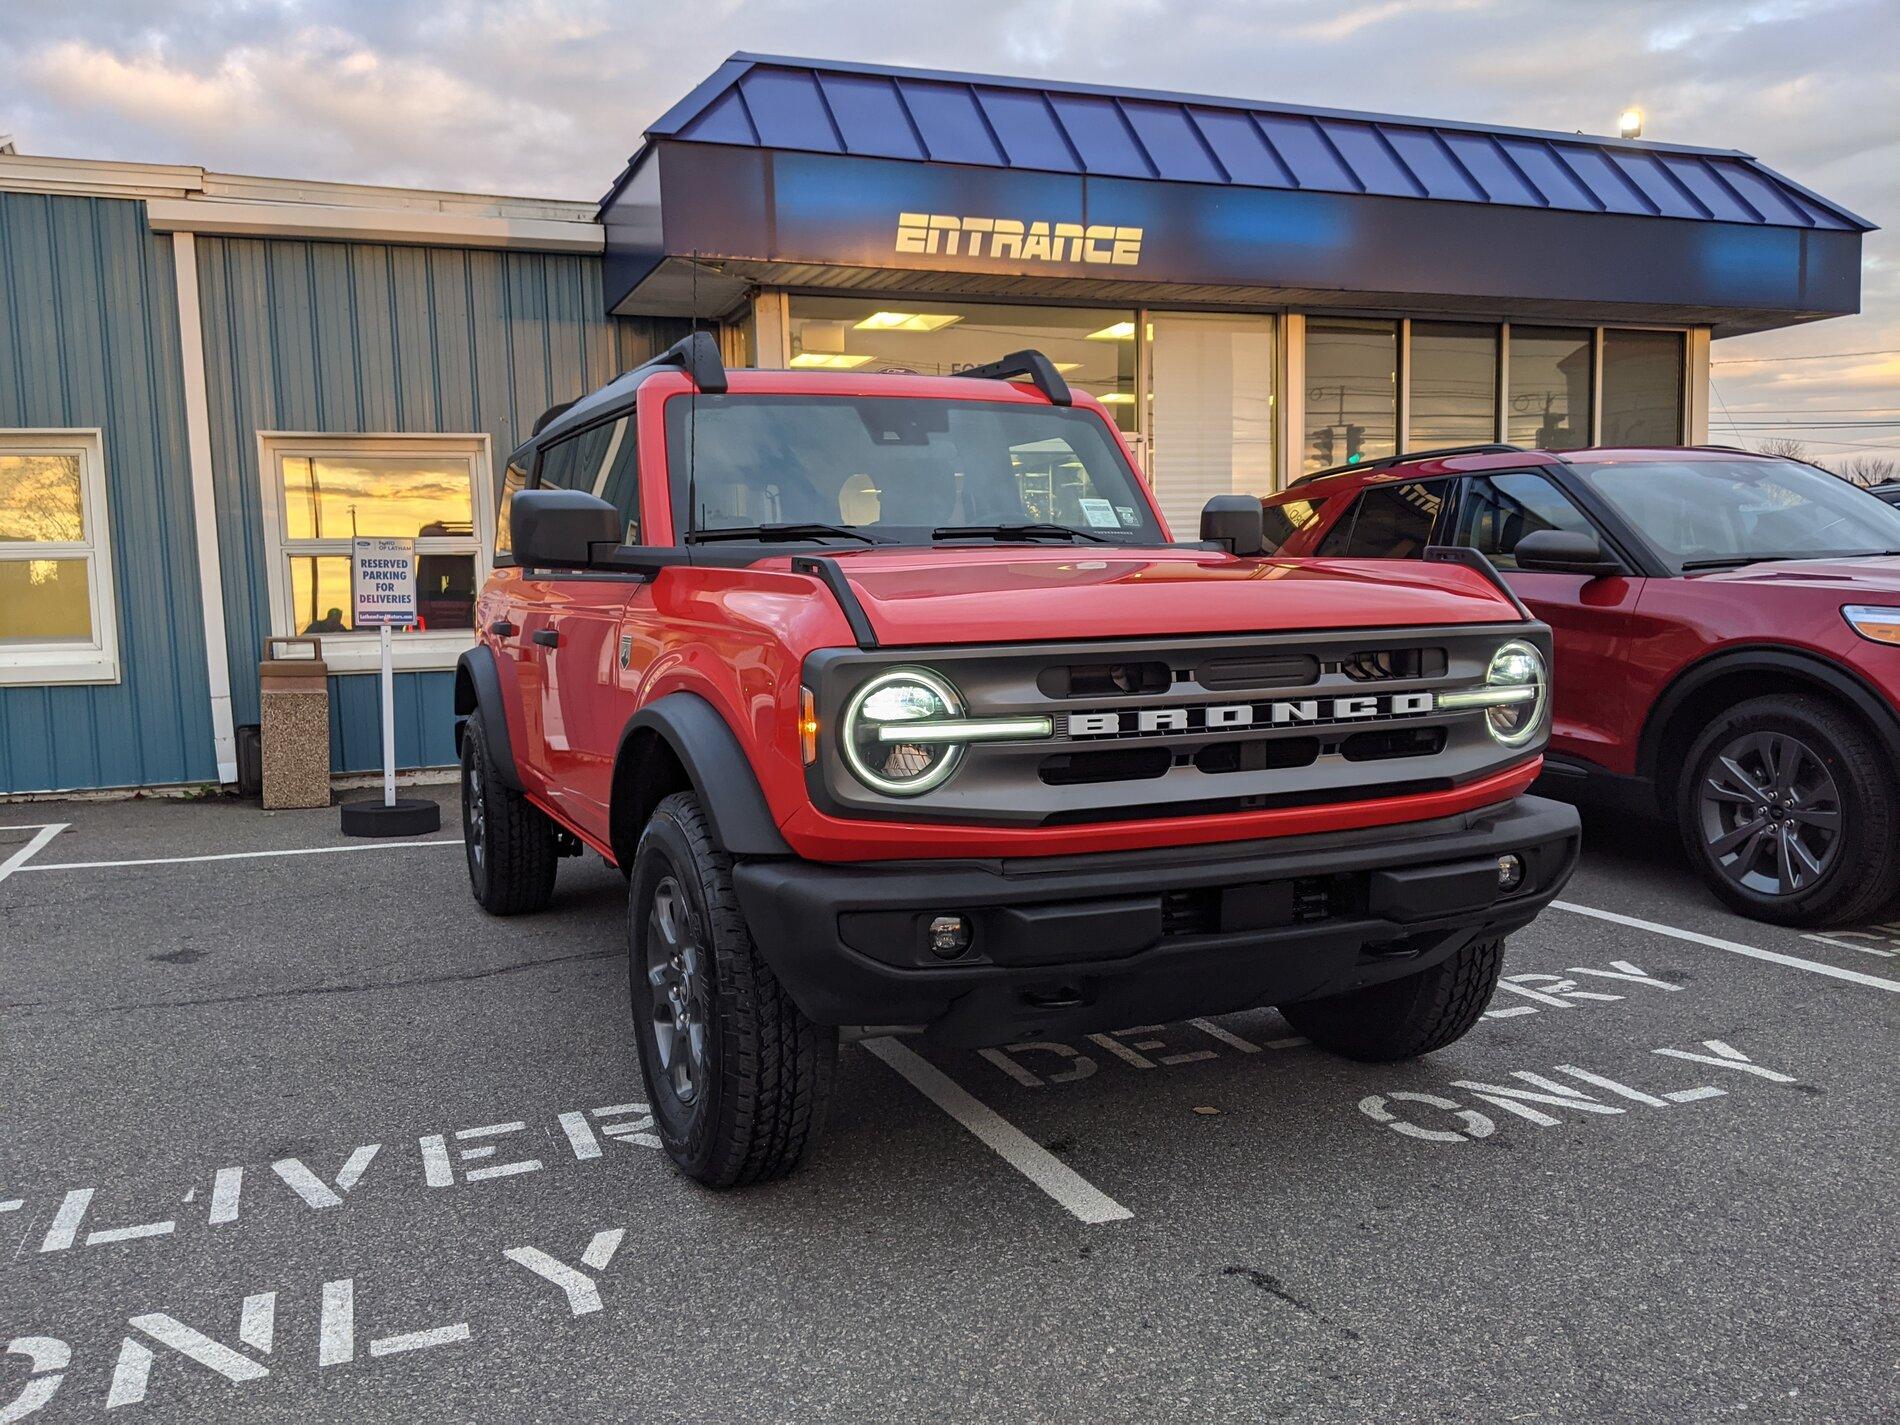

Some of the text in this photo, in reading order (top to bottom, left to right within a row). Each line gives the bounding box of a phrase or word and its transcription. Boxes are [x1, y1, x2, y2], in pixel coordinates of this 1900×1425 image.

[895, 212, 1143, 265] ENTRANCE
[361, 559, 408, 569] RESERVED
[363, 571, 407, 581] PARKING
[376, 583, 395, 592] FOR
[359, 594, 412, 604] DELIVERIES
[1068, 692, 1433, 735] BRONCO
[1358, 1039, 1797, 1142] ONLY
